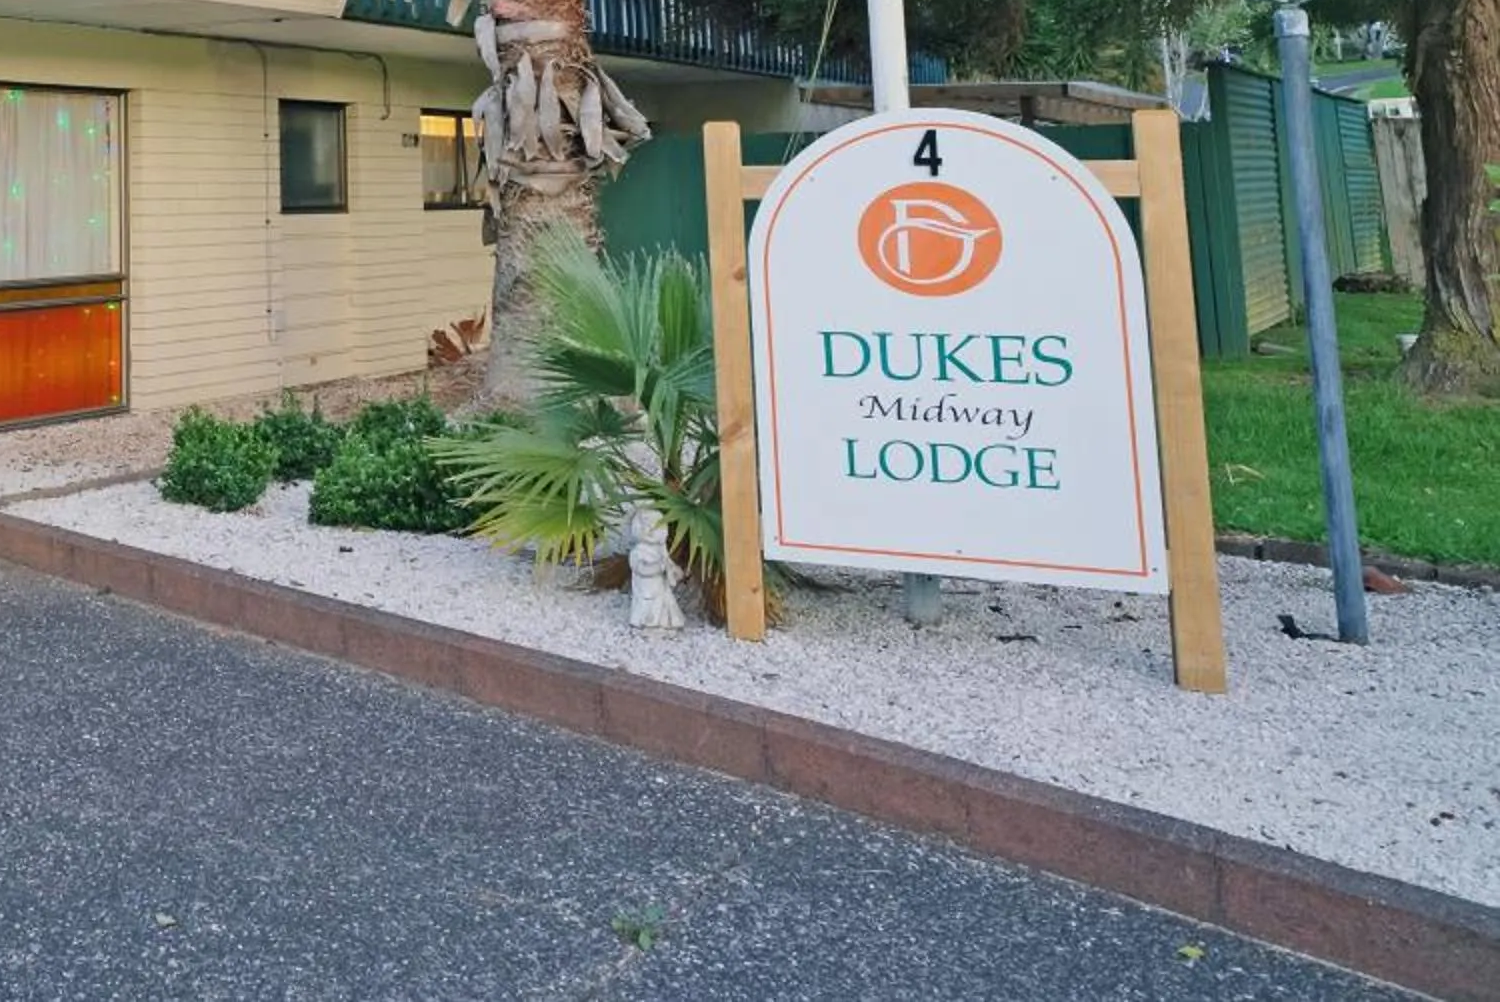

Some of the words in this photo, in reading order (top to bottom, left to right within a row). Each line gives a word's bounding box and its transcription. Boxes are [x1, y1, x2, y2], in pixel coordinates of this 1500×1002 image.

[913, 129, 942, 177] 4
[819, 330, 1073, 388] DUKES
[859, 394, 1034, 440] Midway
[841, 437, 1061, 491] LODGE
